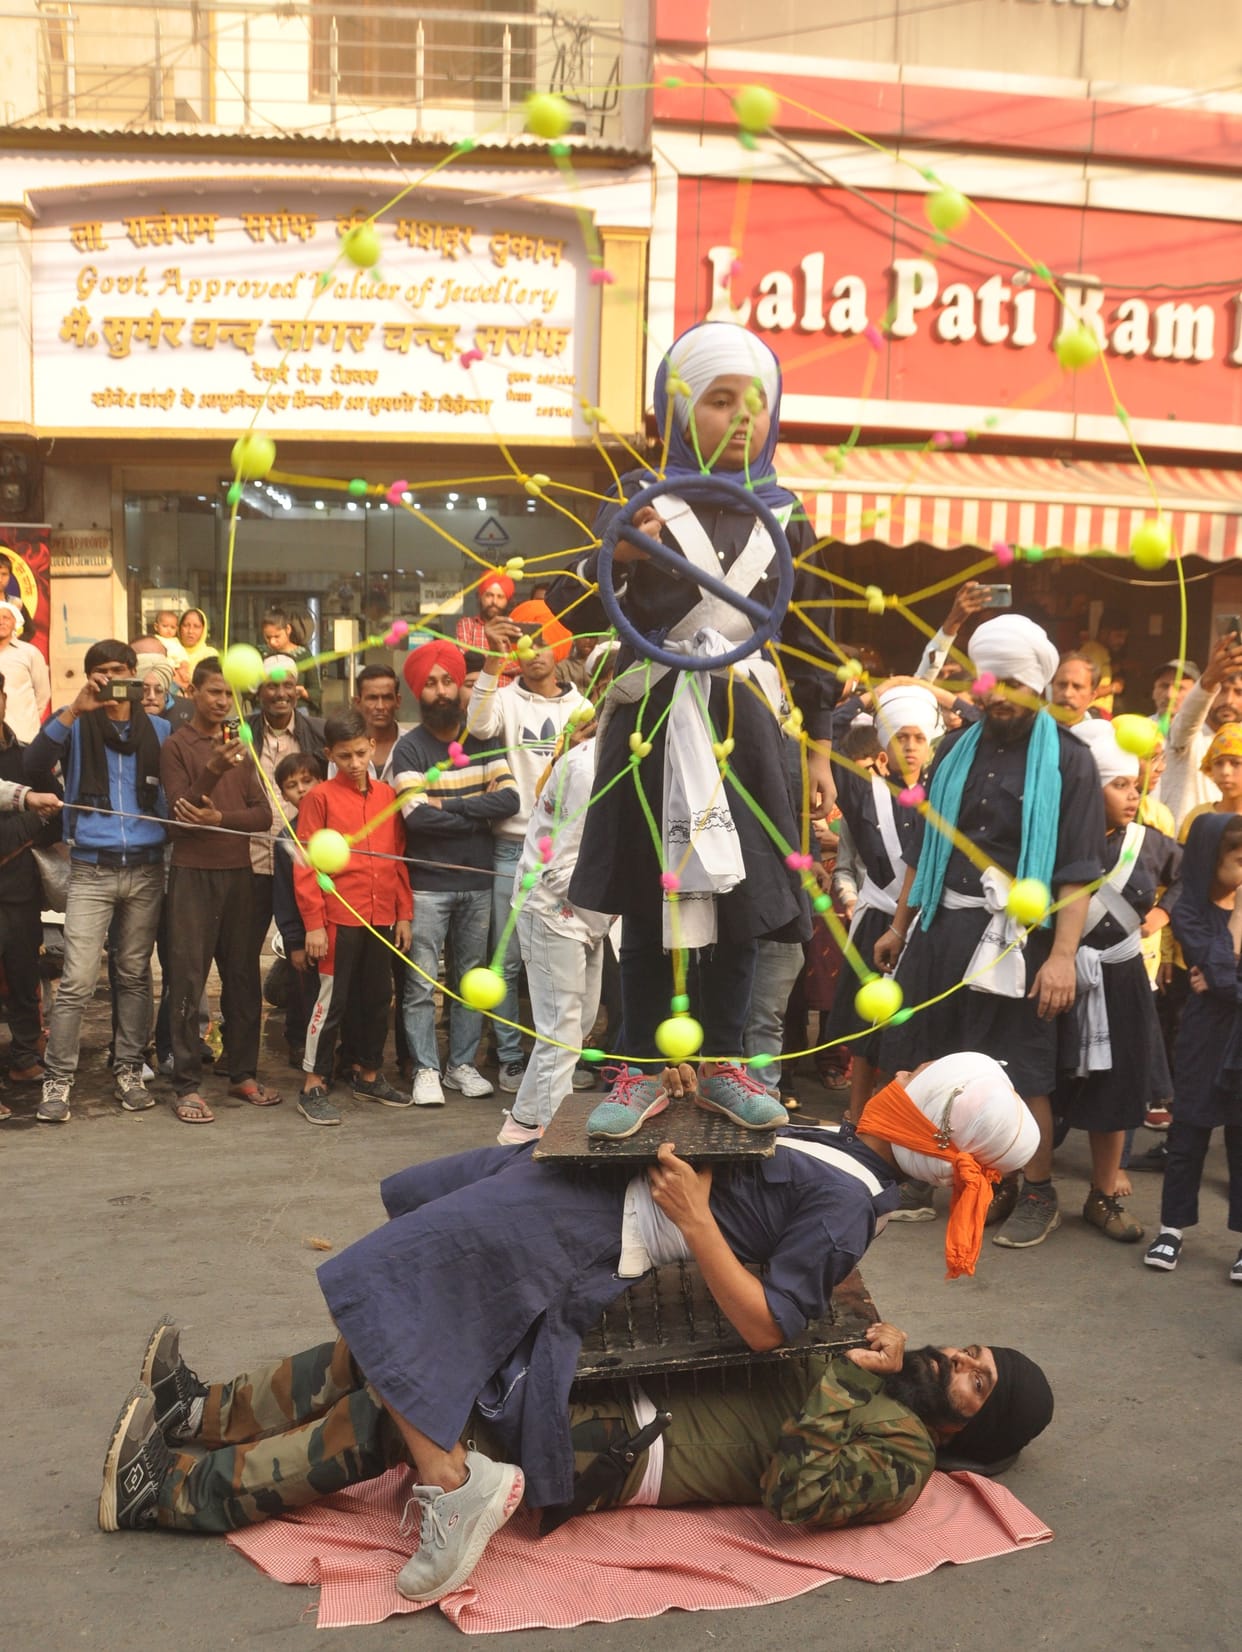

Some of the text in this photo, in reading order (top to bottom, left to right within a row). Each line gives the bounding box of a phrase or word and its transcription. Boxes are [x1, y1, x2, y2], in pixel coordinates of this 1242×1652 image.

[158, 266, 306, 303] Approved
[309, 270, 400, 301] Valuer
[404, 277, 436, 309] of
[435, 276, 559, 313] Jewellery
[706, 245, 868, 332] Lala
[890, 256, 1038, 347] Pati
[1056, 272, 1215, 362] Ram
[270, 319, 376, 353] सागर
